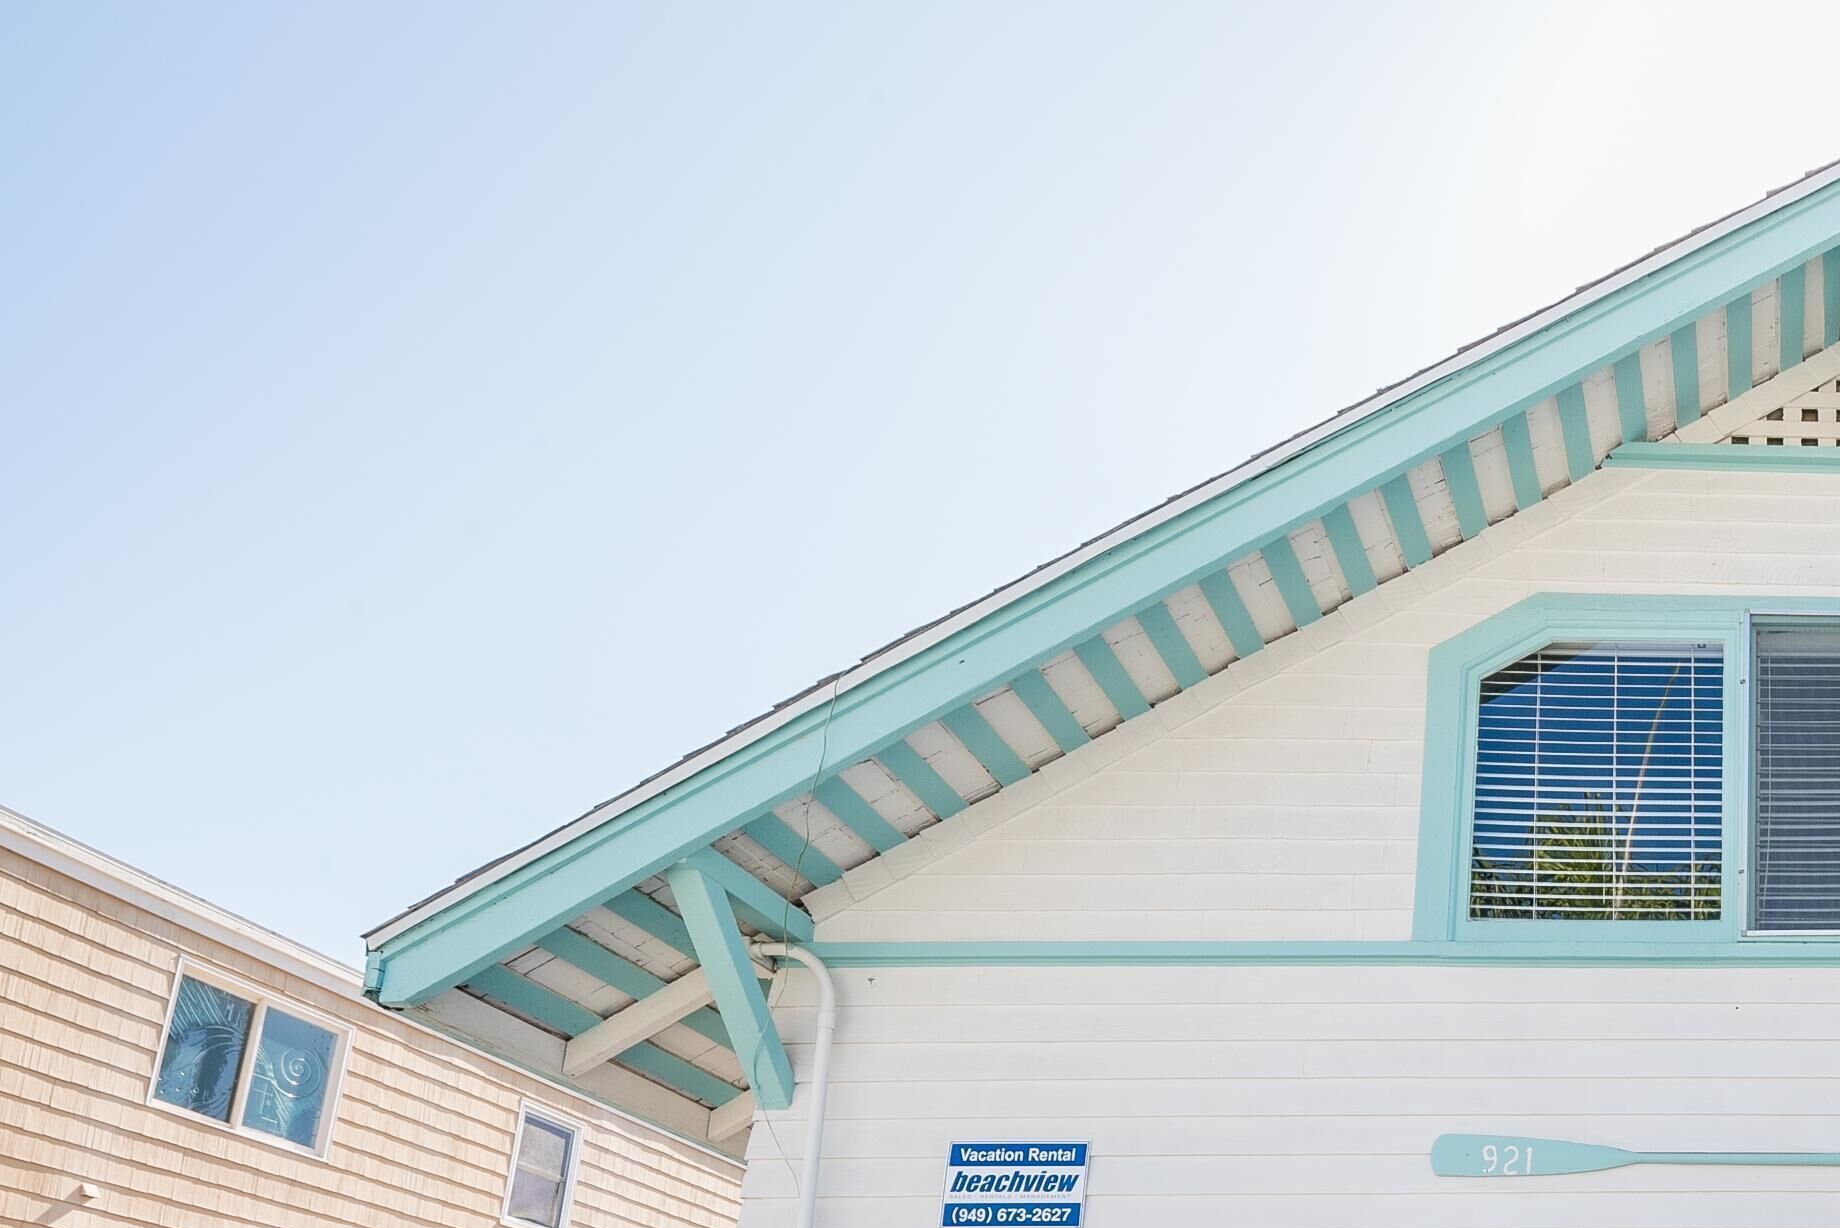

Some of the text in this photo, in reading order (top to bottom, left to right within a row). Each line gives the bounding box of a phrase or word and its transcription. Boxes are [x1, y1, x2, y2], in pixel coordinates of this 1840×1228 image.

[960, 1147, 1076, 1162] Vacation Rental
[1482, 1144, 1534, 1176] 921
[950, 1170, 1080, 1193] beachview
[952, 1206, 1072, 1224] (949) 673-2627
